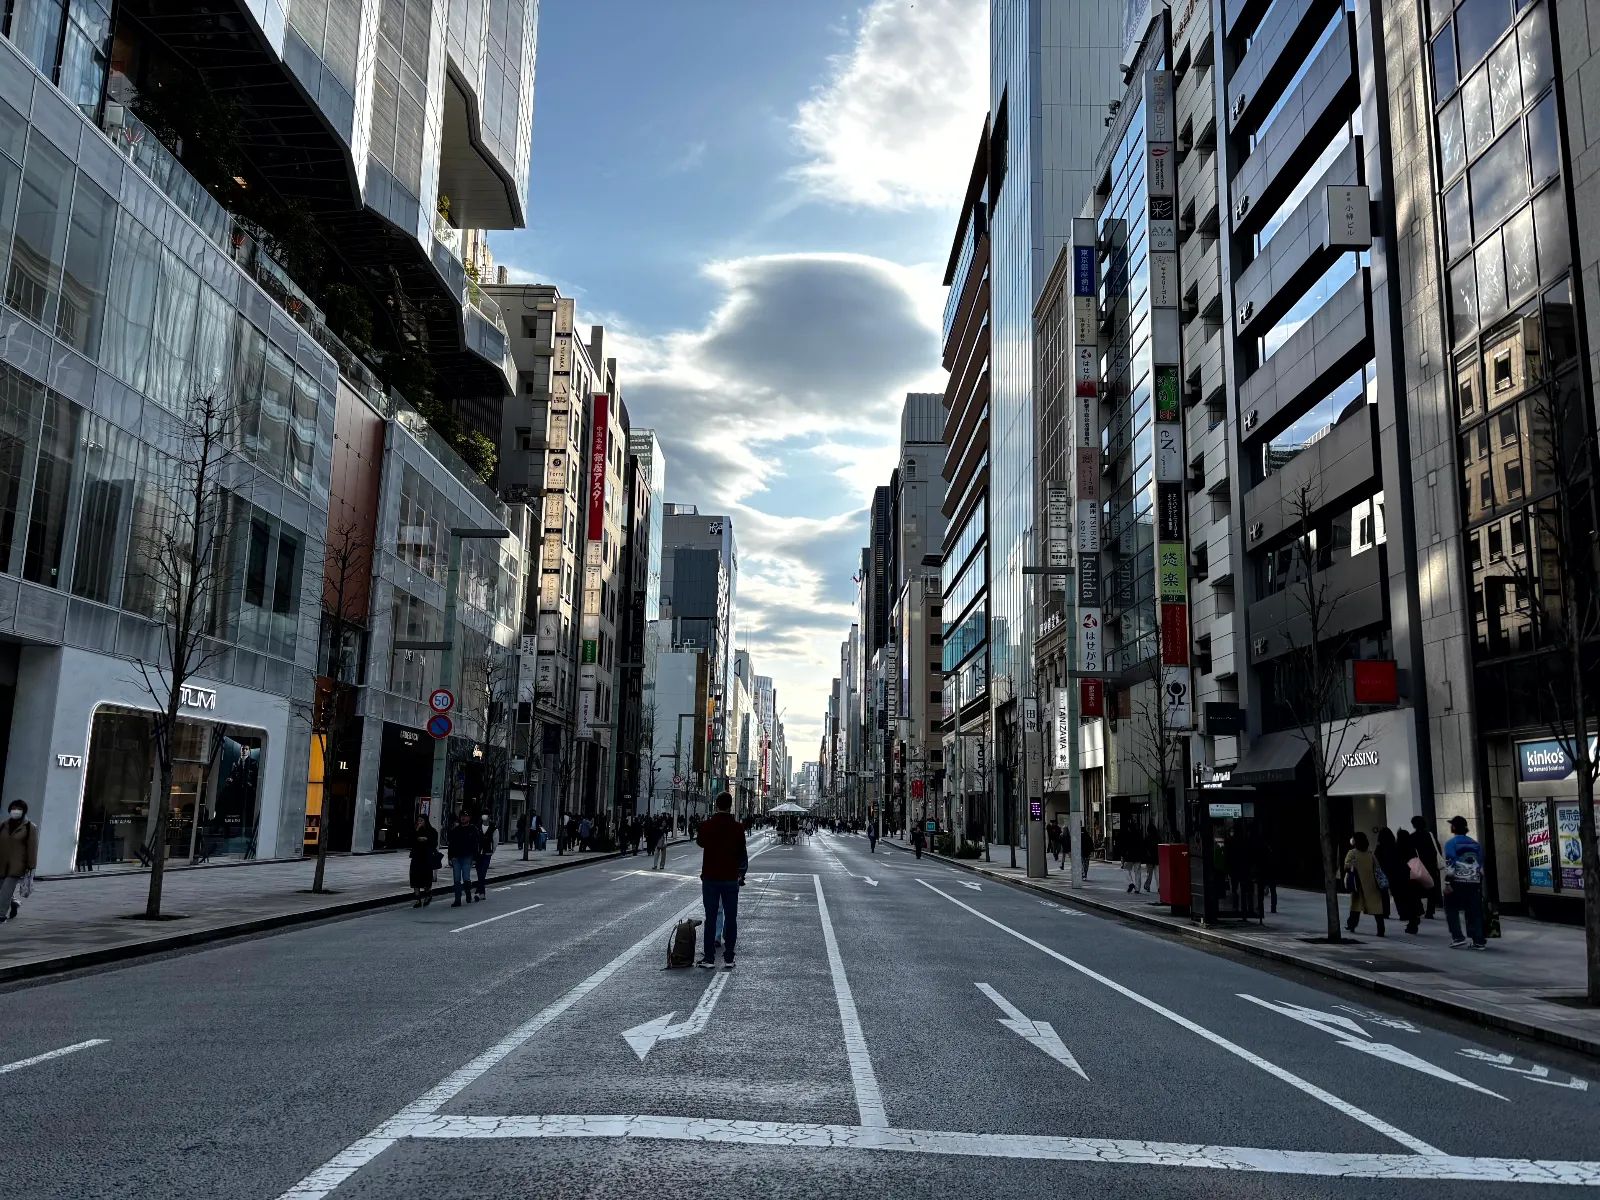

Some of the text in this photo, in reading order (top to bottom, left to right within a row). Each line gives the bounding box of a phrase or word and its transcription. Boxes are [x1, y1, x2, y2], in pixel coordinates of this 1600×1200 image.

[1151, 200, 1172, 219] 彩
[1151, 226, 1173, 234] AYA
[592, 452, 605, 509] 銀座アスター
[1079, 519, 1088, 550] クリニック
[1082, 555, 1097, 599] Ishida
[1161, 551, 1179, 587] 悠楽
[1085, 630, 1097, 671] はせがわ
[180, 684, 216, 710] TUMI
[434, 694, 449, 709] 50
[1058, 706, 1068, 750] TANIZAWA
[57, 754, 82, 769] TUMI
[977, 743, 985, 769] POLA
[1526, 747, 1565, 766] kinko's
[1558, 808, 1581, 822] 展示会
